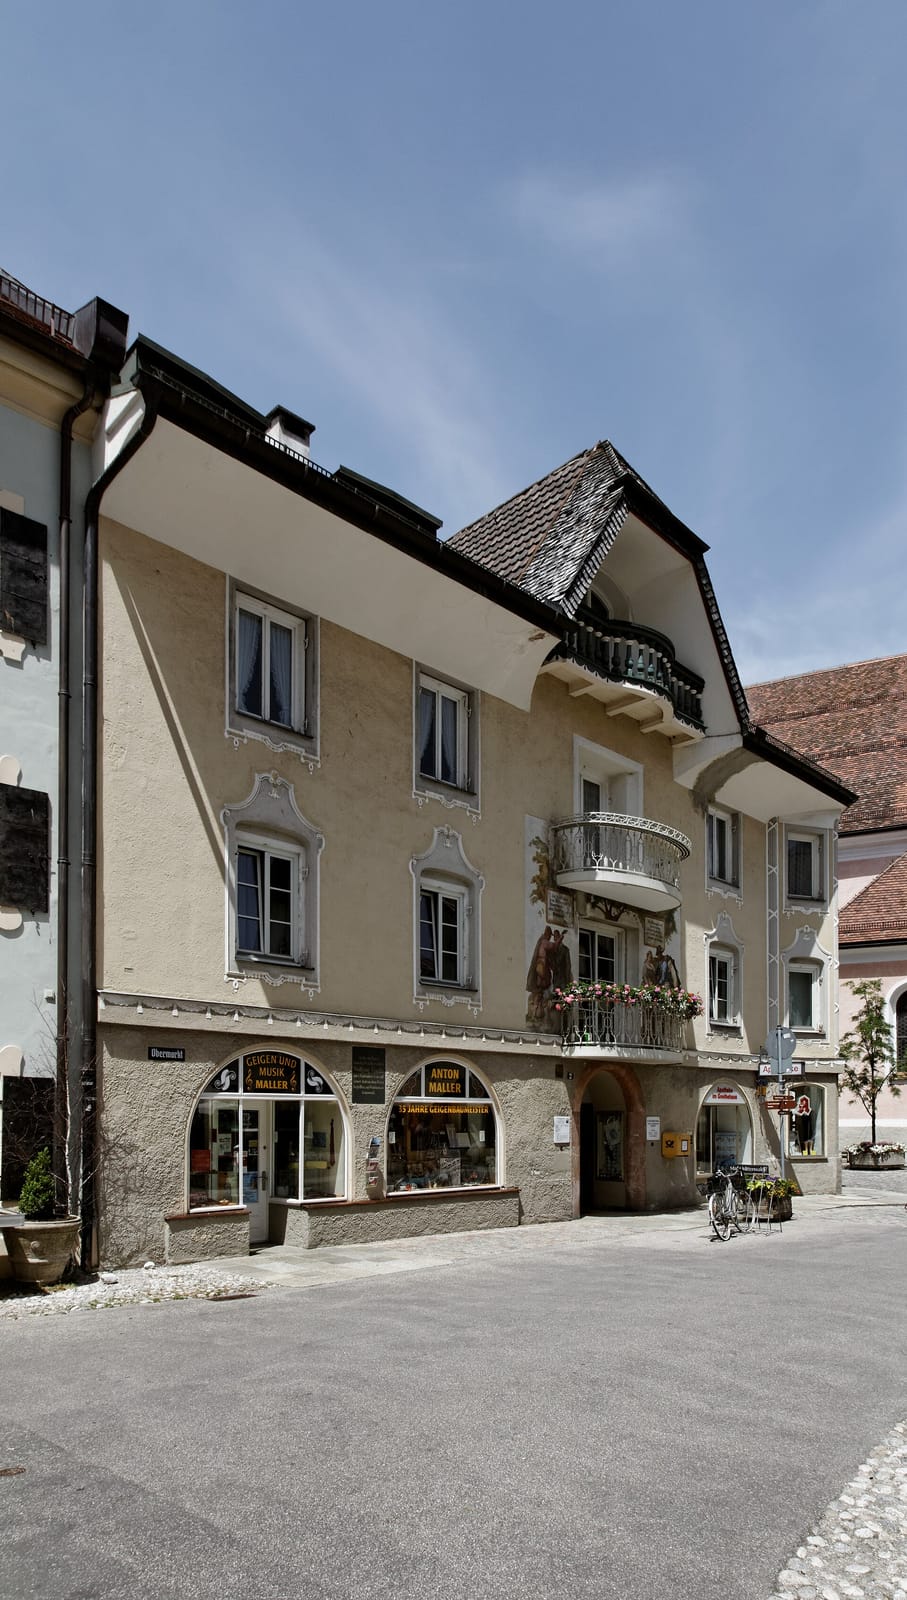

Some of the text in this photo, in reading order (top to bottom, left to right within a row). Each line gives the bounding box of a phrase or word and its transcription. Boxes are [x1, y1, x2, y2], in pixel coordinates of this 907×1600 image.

[151, 1048, 184, 1059] Obermarkt
[246, 1055, 297, 1069] GEIGEN UND
[259, 1067, 285, 1077] MUSIK
[431, 1068, 460, 1079] ANTON
[255, 1080, 288, 1089] MALLER
[428, 1082, 461, 1093] MALLER
[407, 1105, 428, 1113] JAHRE
[429, 1105, 489, 1114] GEIGENBAUMEISTER
